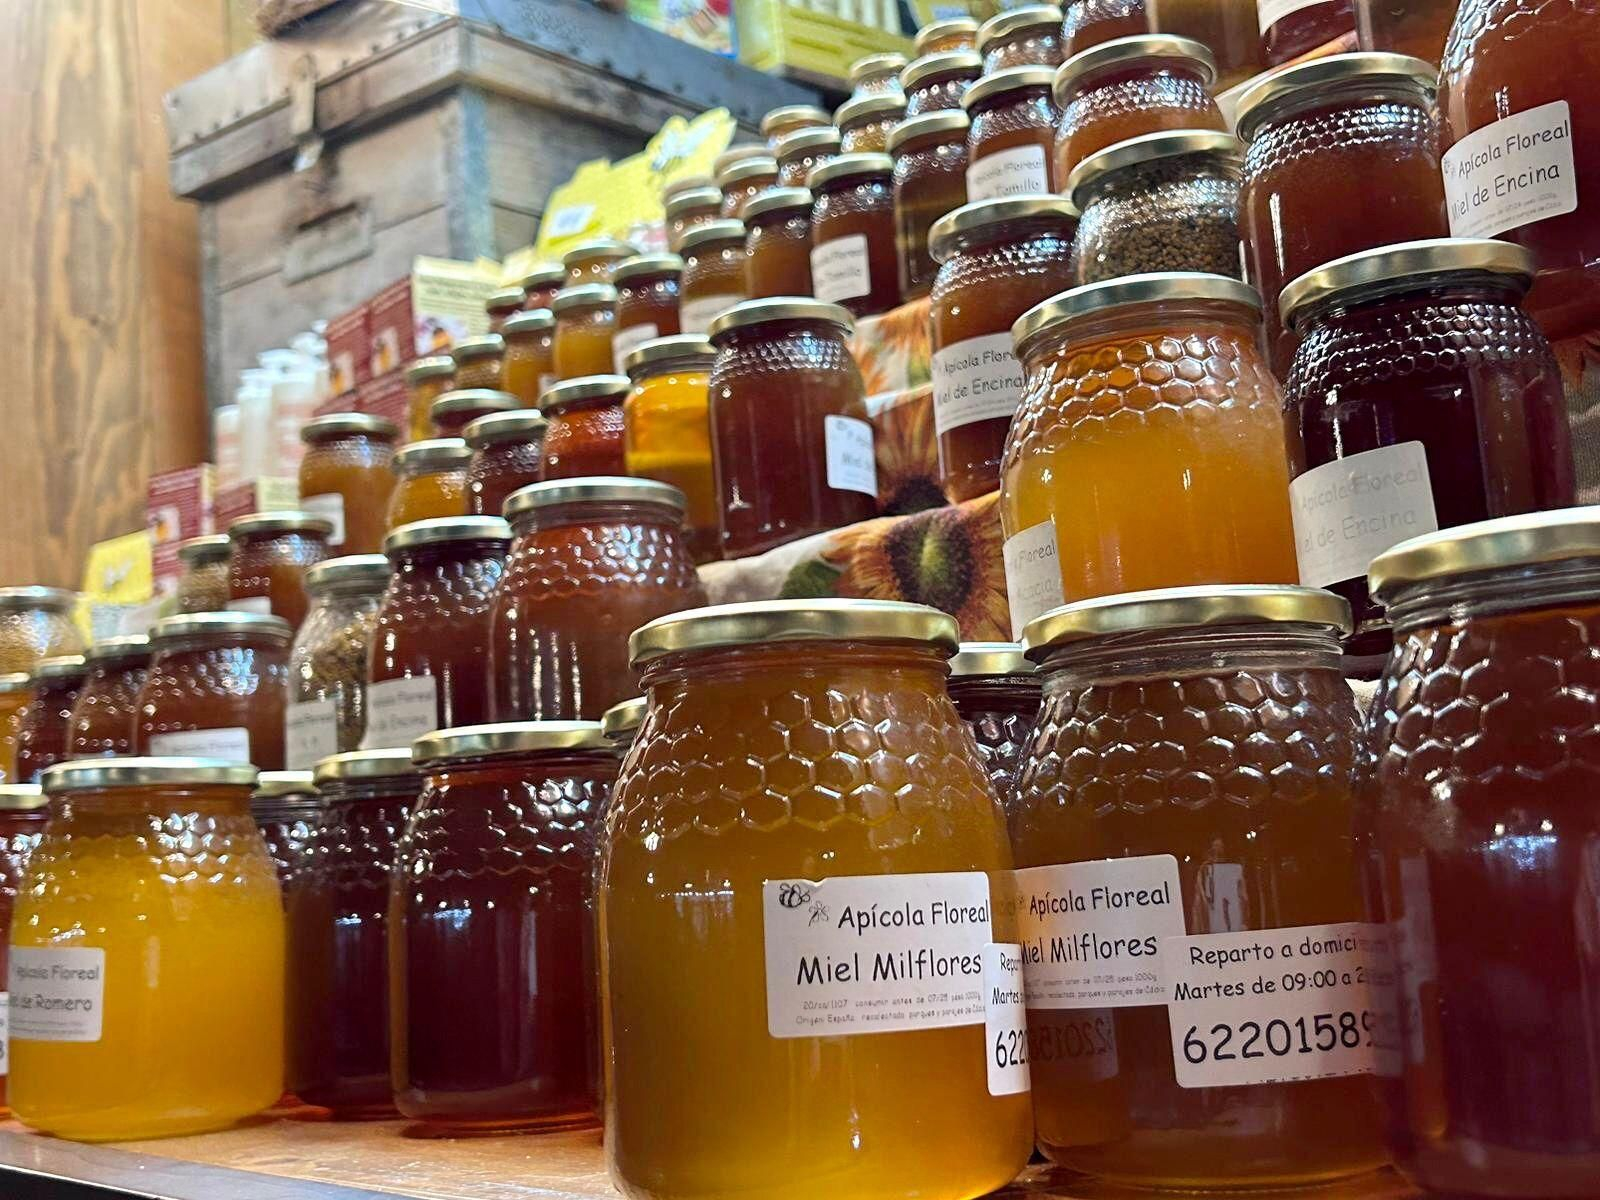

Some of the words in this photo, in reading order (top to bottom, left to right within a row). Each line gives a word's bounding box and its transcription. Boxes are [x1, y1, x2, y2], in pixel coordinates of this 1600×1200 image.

[1459, 145, 1501, 179] Apícola
[1506, 119, 1569, 155] Floreal
[1472, 185, 1490, 207] de
[1495, 164, 1560, 197] Encina
[1351, 463, 1425, 494] Floreal
[1317, 524, 1336, 547] de
[1342, 508, 1418, 541] Encina
[1030, 889, 1086, 921] Apícola
[1091, 880, 1171, 910] Floreal
[837, 902, 925, 936] Apícola
[931, 899, 990, 926] Floreal
[1051, 932, 1158, 964] Milflores
[1189, 942, 1275, 970] Reparto
[1281, 945, 1293, 958] a
[51, 963, 100, 982] Floreal
[796, 952, 860, 985] Miel
[872, 948, 982, 982] Milflores
[992, 987, 1019, 1005] Martes
[1174, 980, 1246, 1001] Martes
[1252, 975, 1277, 995] de
[1281, 969, 1337, 992] 09:00
[1342, 972, 1353, 985] a
[34, 993, 93, 1012] Romero
